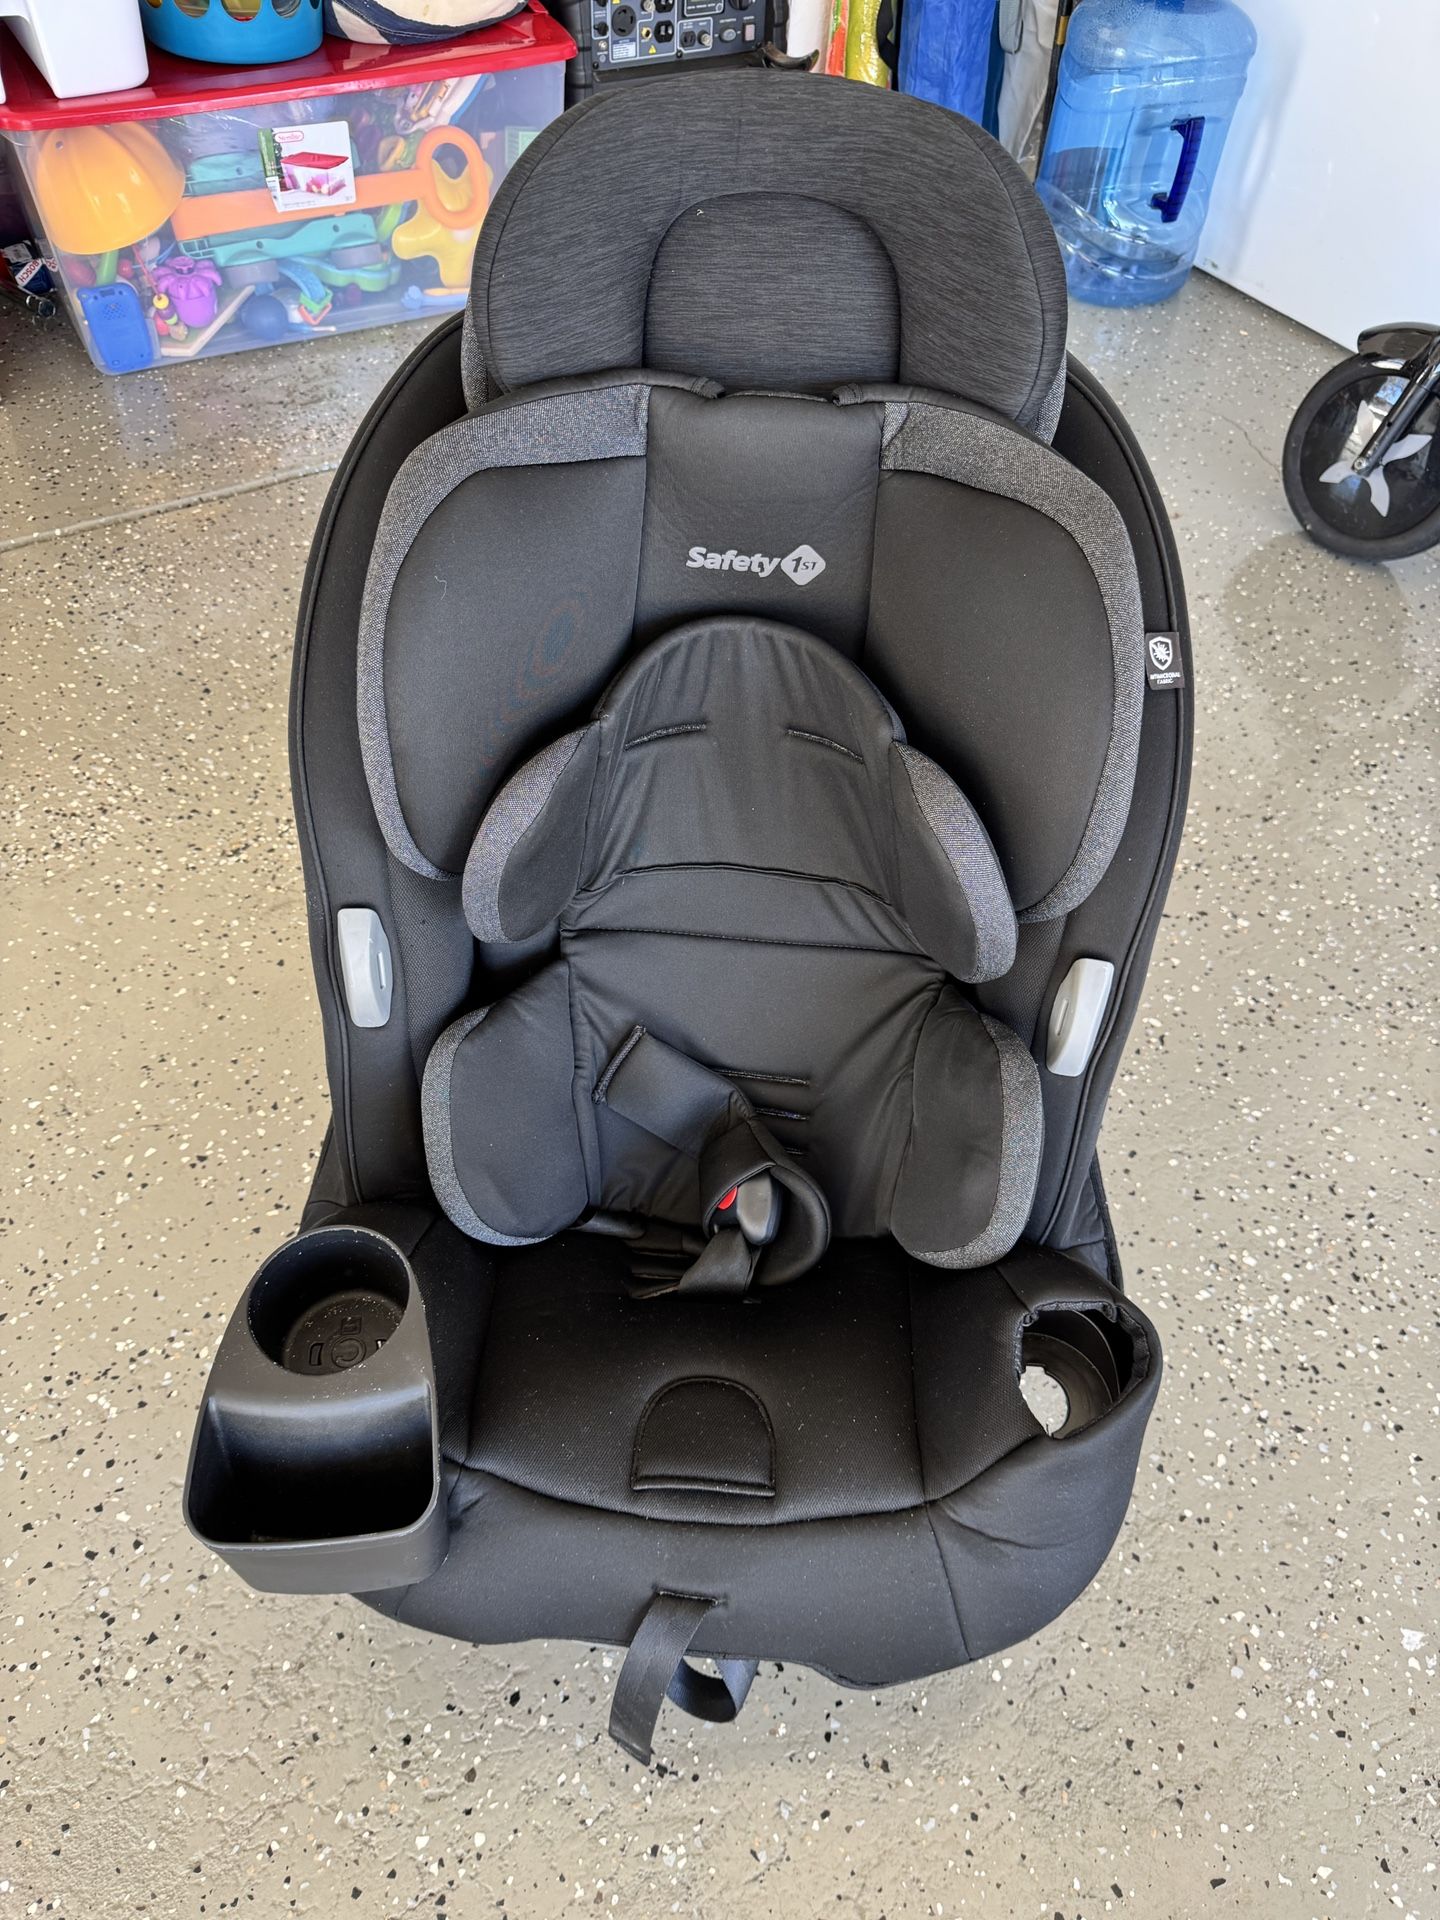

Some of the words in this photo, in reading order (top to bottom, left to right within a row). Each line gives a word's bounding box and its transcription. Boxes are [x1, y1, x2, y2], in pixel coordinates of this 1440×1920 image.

[19, 259, 40, 282] BOSCH
[686, 546, 781, 578] Safety
[791, 556, 818, 573] 1ST
